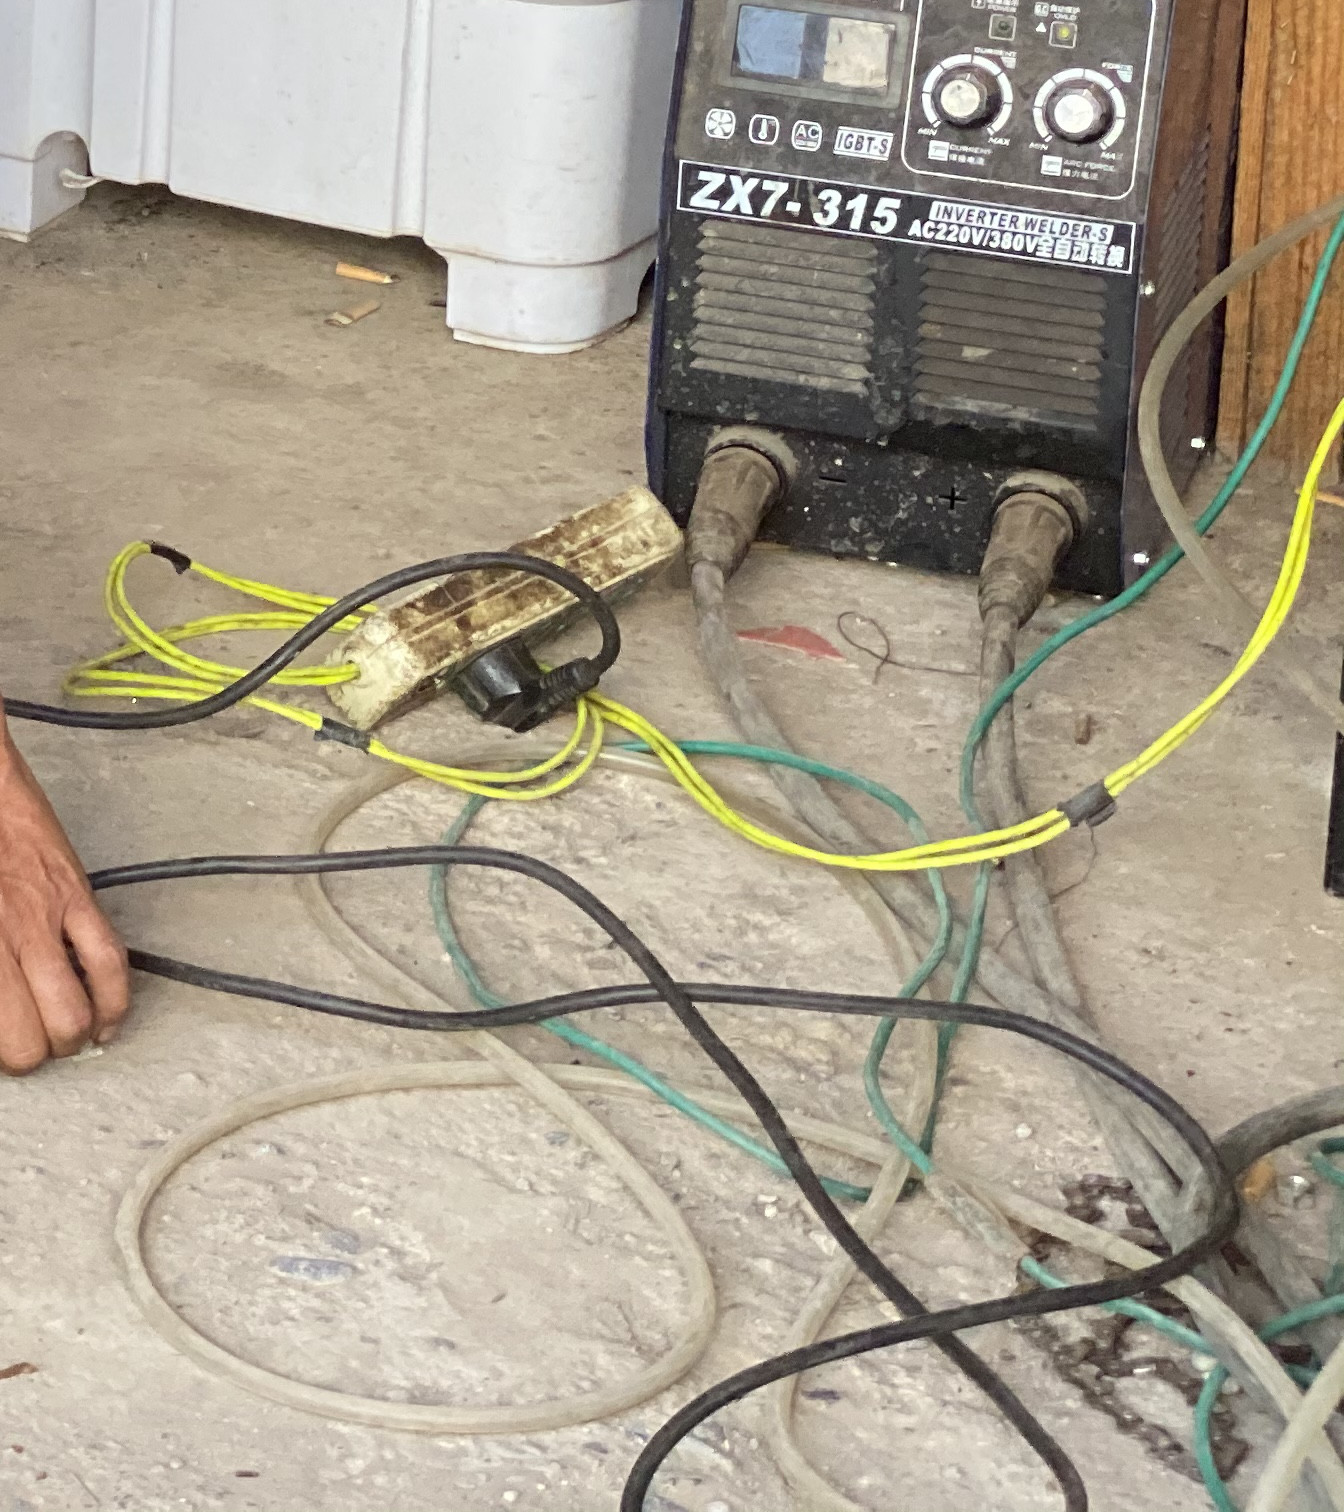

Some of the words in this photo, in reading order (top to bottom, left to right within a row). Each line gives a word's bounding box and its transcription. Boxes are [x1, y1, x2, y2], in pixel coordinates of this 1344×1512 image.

[796, 124, 820, 139] AC
[837, 132, 889, 155] IGBT-S
[935, 204, 1020, 229] INVERTER
[1025, 219, 1109, 242] WELDER-S
